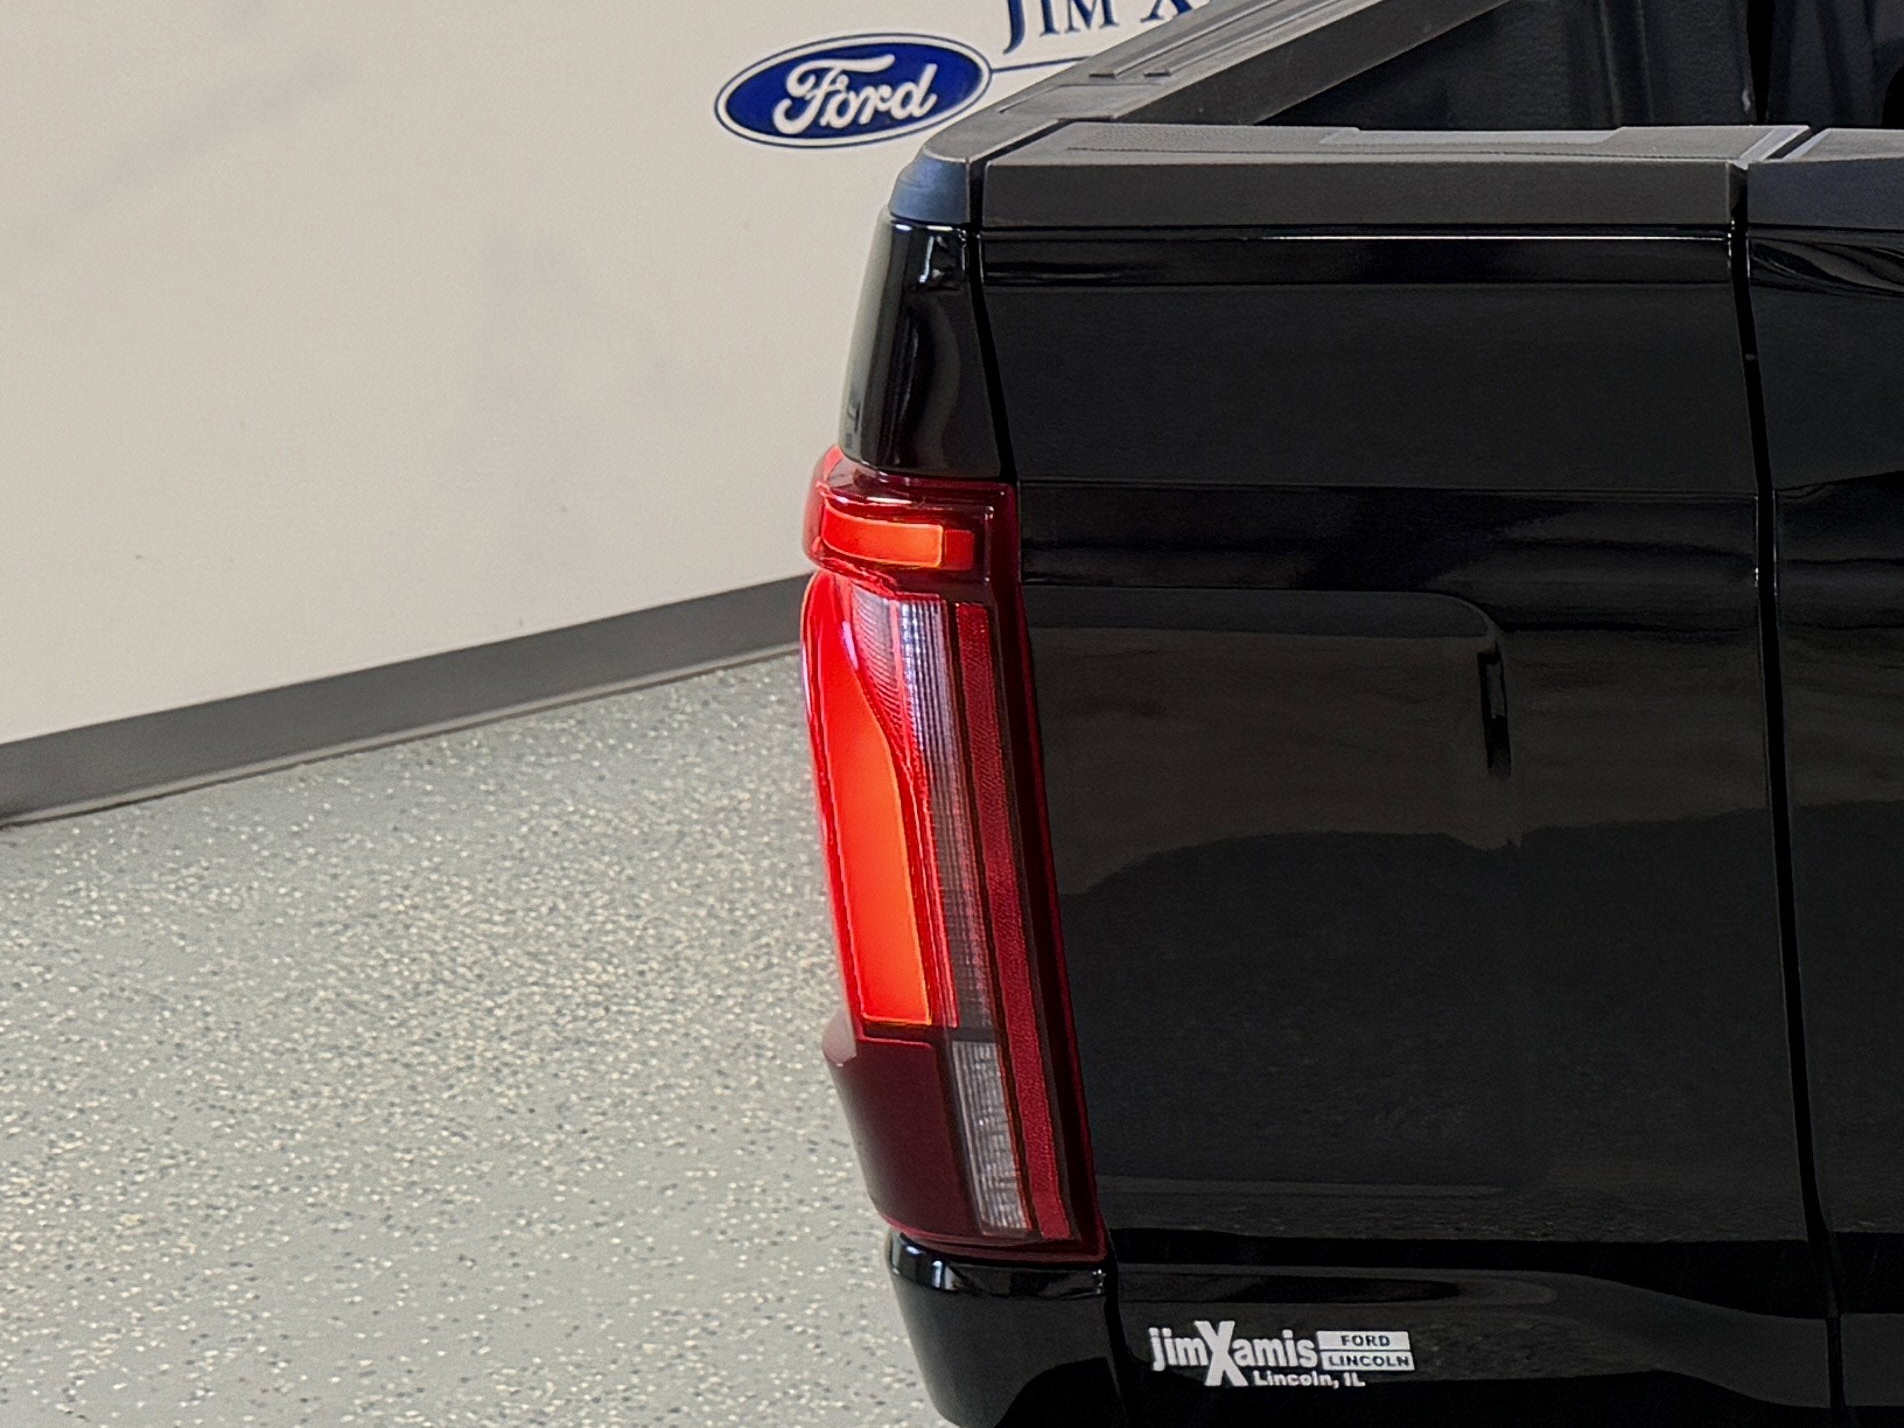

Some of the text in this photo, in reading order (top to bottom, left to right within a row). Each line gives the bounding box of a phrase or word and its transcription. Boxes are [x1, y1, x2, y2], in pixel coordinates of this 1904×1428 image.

[772, 54, 938, 134] Ford
[1340, 1334, 1391, 1347] FORD
[1328, 1355, 1410, 1368] LINCOLN
[1252, 1370, 1367, 1389] Lincoln, IL
